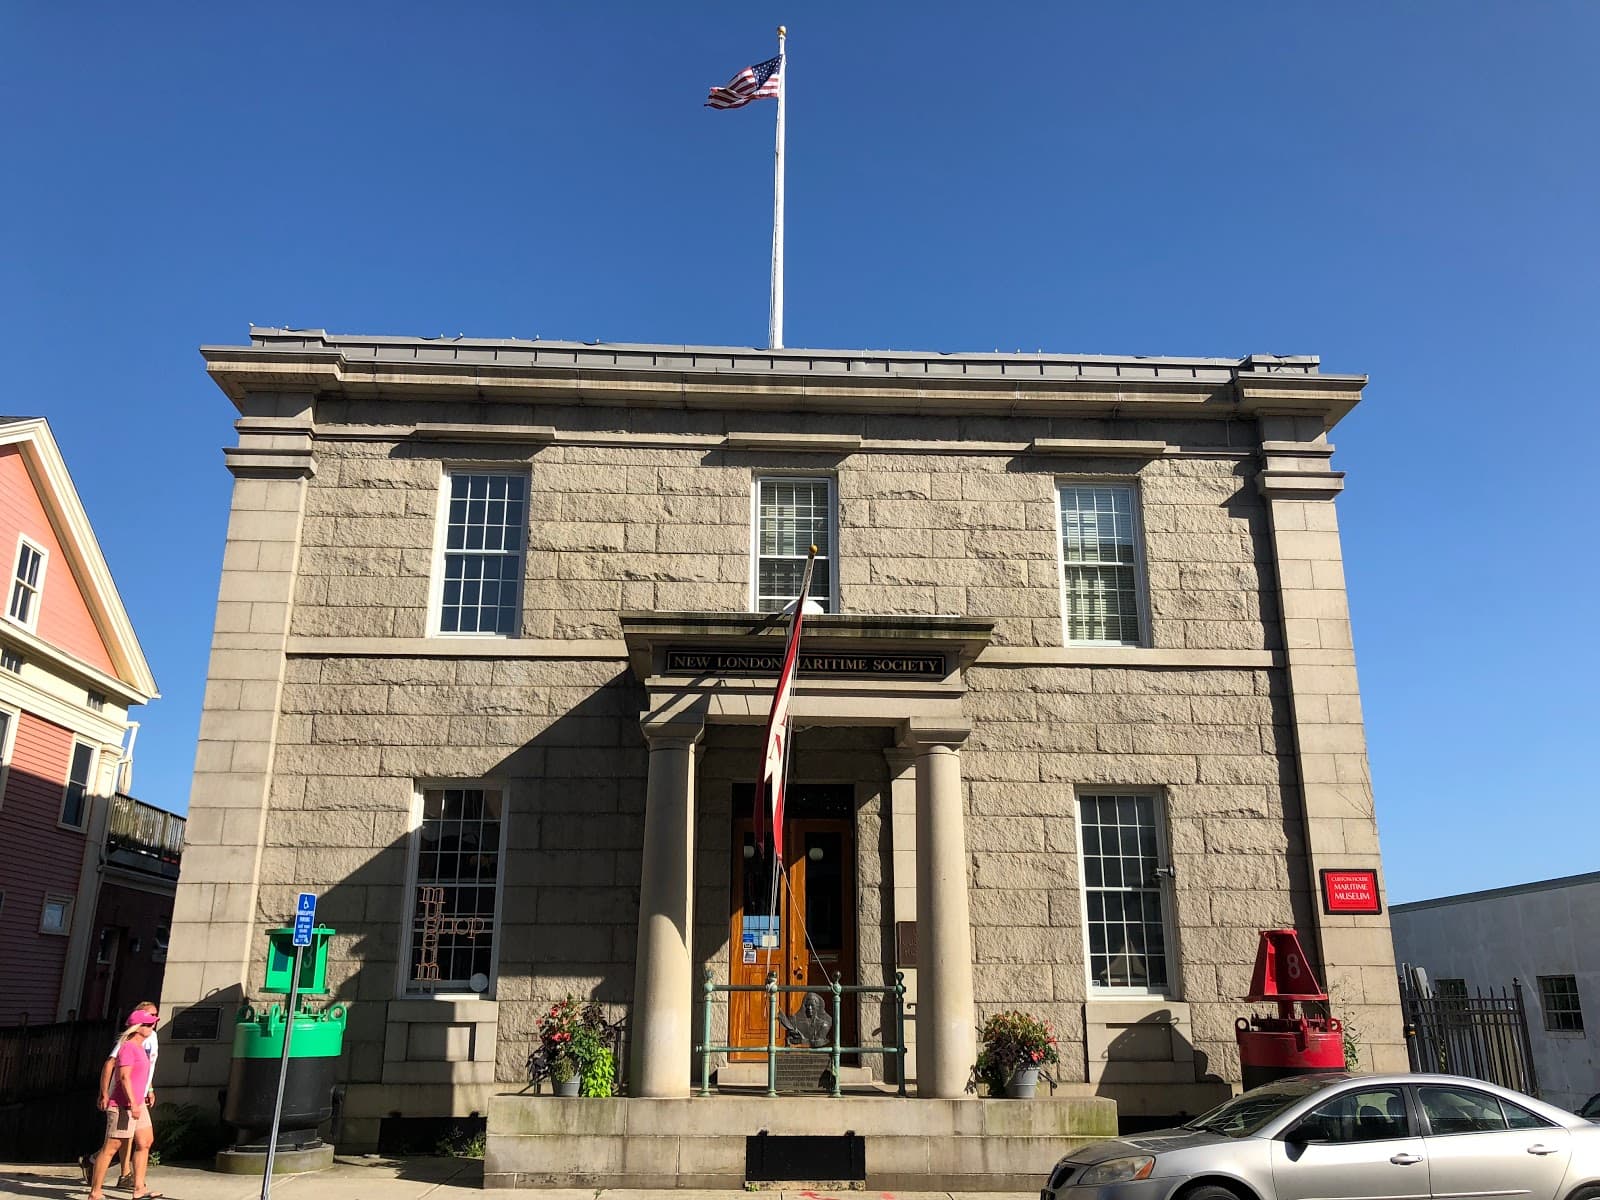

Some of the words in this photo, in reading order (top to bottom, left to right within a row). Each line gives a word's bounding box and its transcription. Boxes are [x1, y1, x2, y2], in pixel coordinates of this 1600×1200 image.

[673, 655, 711, 668] NEW
[717, 656, 782, 669] LONDON
[872, 659, 939, 673] SOCIETY
[1334, 883, 1369, 891] MARITIME
[1334, 892, 1370, 901] MUSEUM
[413, 886, 447, 982] museum
[1286, 953, 1301, 979] 8
